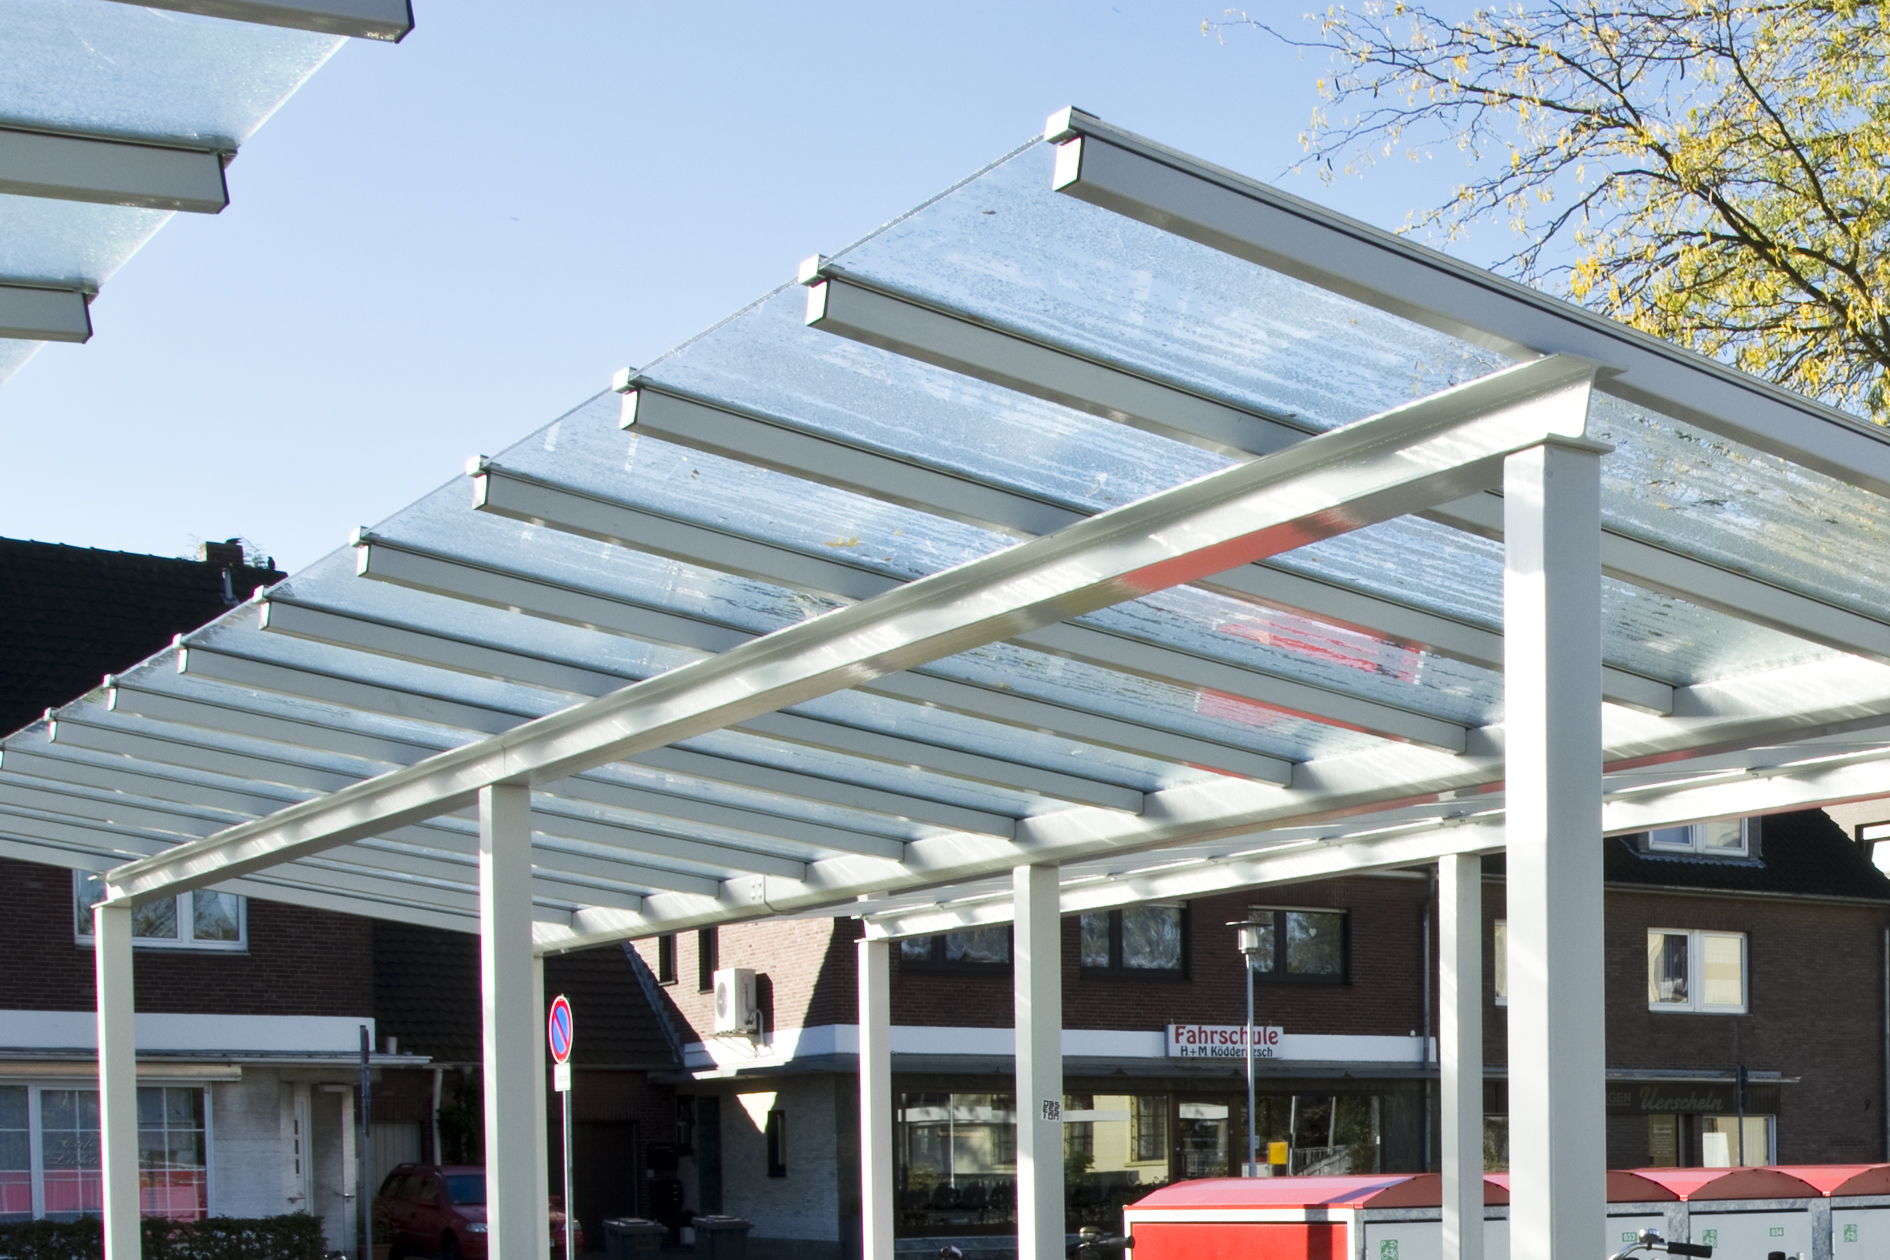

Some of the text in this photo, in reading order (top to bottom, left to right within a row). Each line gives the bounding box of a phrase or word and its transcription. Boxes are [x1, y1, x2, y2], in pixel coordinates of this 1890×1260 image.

[1175, 1026, 1279, 1045] Fahrschule
[1211, 1046, 1273, 1057] Ködderzsch
[1771, 1228, 1783, 1236] 034
[1623, 1233, 1636, 1241] 033
